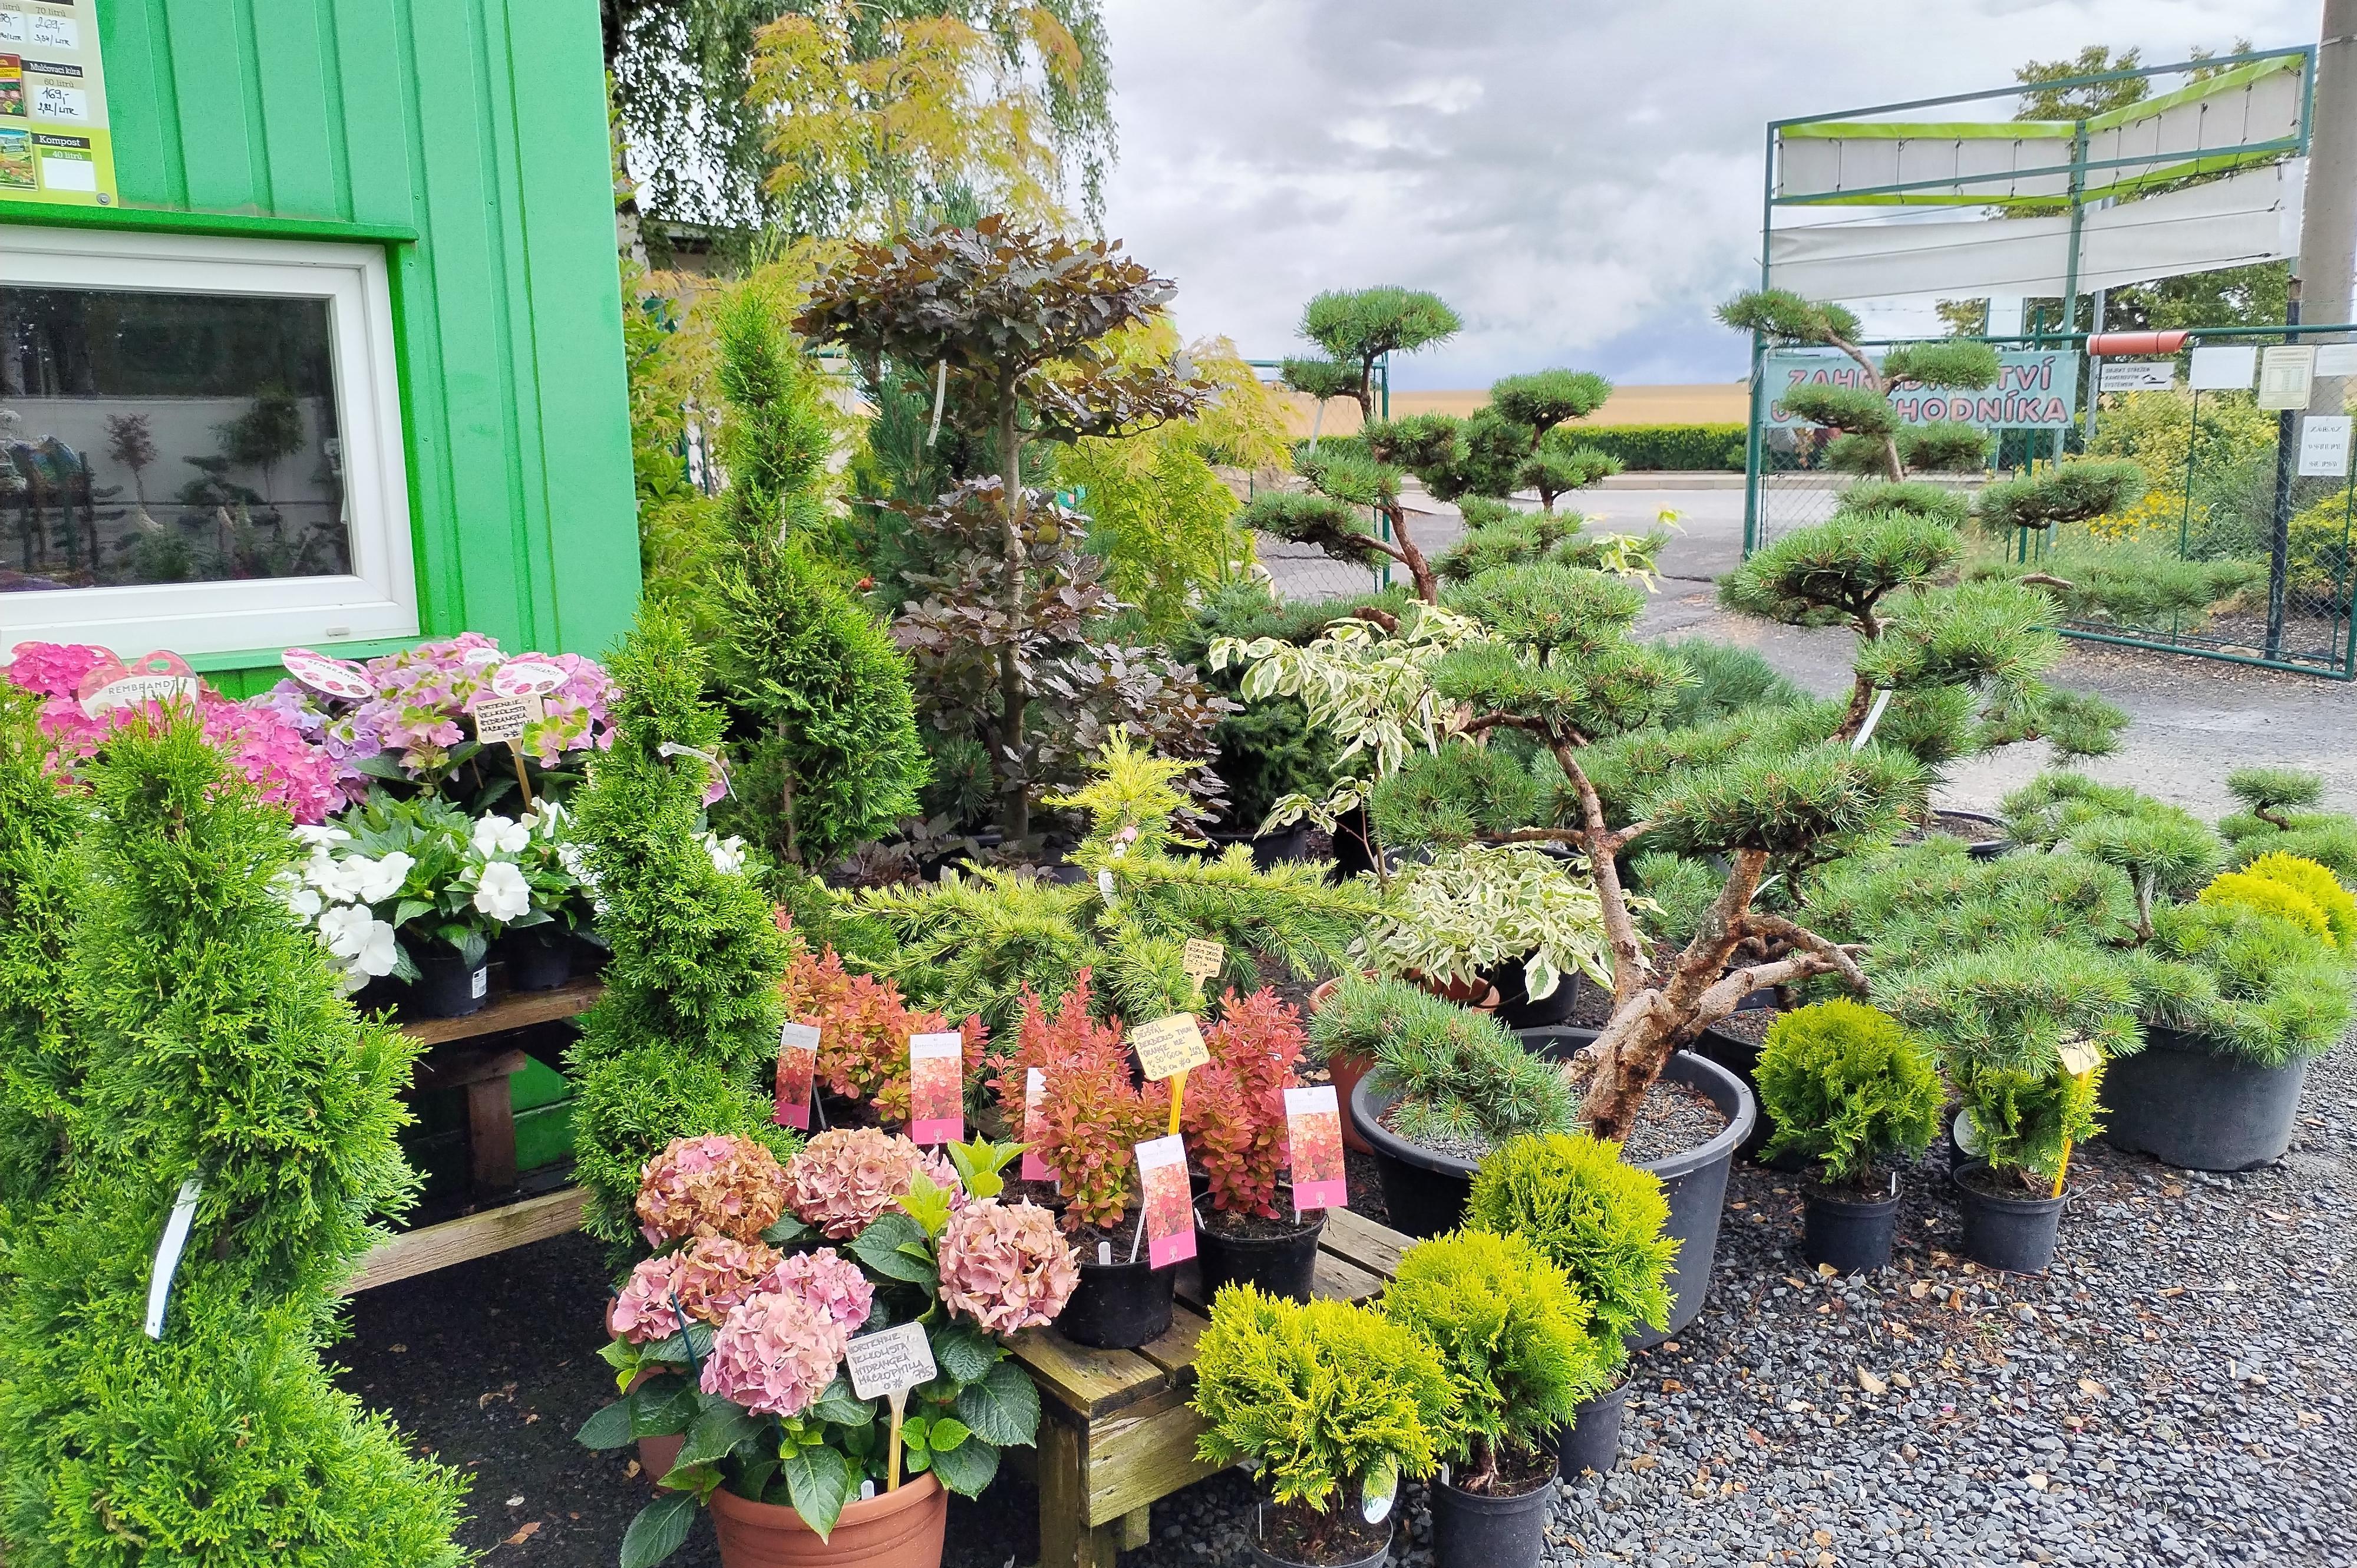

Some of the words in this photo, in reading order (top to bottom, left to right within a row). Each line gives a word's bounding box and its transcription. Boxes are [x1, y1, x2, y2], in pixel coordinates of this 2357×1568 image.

[48, 8, 66, 17] litrů
[57, 79, 74, 88] litrů
[38, 135, 81, 147] Kompost
[65, 151, 82, 160] litrů
[308, 659, 362, 683] REMBRANDT
[108, 679, 176, 695] REMBRANDT
